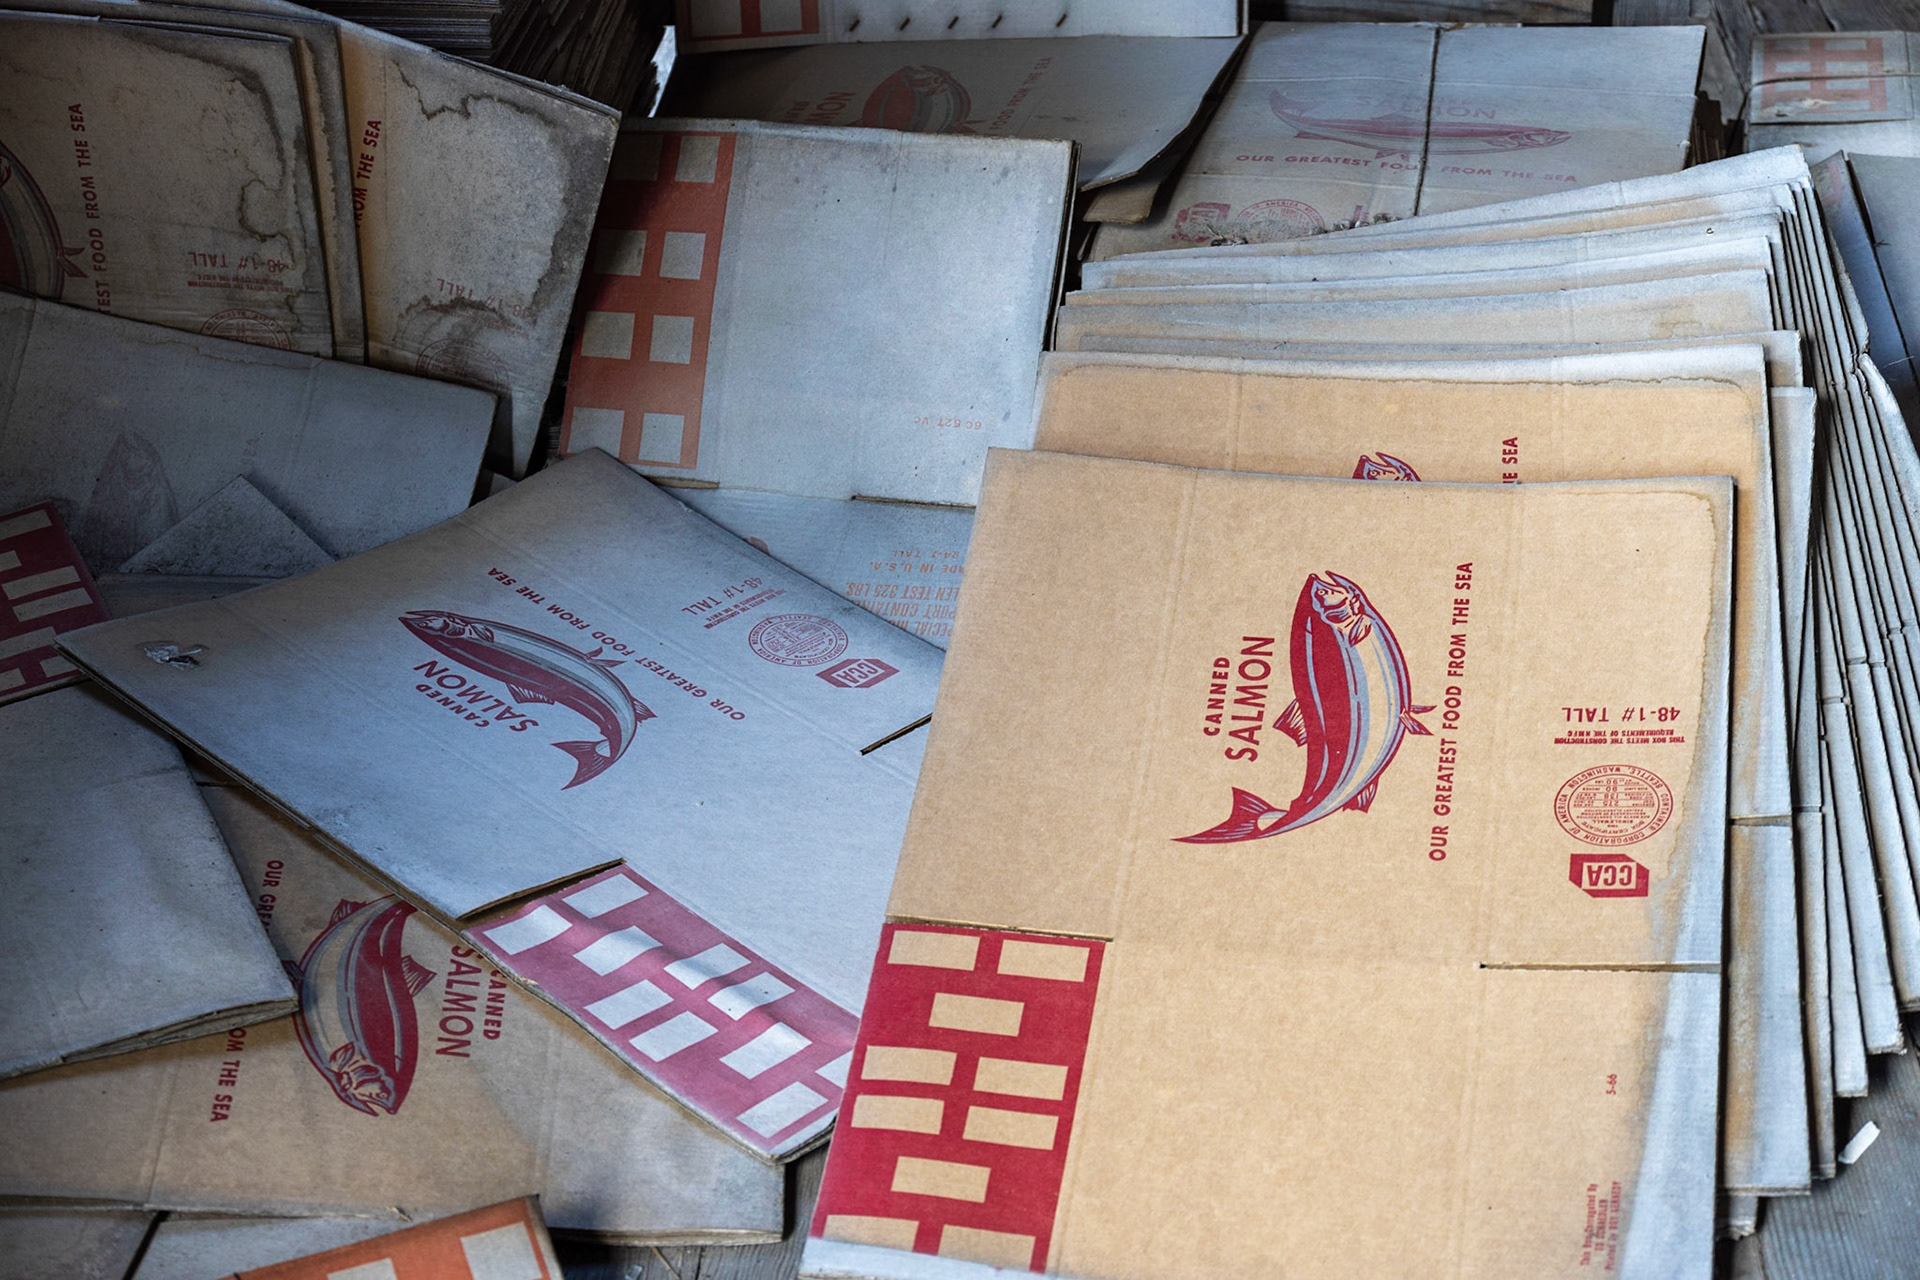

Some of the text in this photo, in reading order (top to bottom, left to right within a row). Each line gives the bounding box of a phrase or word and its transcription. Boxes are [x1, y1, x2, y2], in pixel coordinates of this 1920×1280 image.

[68, 103, 85, 132] SEA
[75, 139, 92, 168] THE
[1236, 155, 1275, 163] OUR
[1284, 155, 1373, 168] GREATEST
[1441, 166, 1493, 177] FROM
[1502, 170, 1534, 180] THE
[353, 120, 382, 228] ROM THE SEA
[80, 176, 100, 219] FROM
[89, 228, 107, 272] FOOD
[188, 252, 229, 268] TALL
[1501, 436, 1518, 465] SEA
[920, 563, 935, 573] IN
[681, 576, 763, 616] 48-1# TALL
[873, 584, 899, 599] 325
[901, 585, 932, 601] TEST
[487, 567, 746, 721] OUR GREATEST FOOD FROM THE SEA
[836, 662, 879, 685] CCA
[413, 660, 539, 732] SALMON
[415, 684, 490, 728] CANNED
[1203, 657, 1230, 736] CANNED
[1224, 636, 1275, 762] SALMON
[1428, 562, 1473, 861] OUR GREATEST FOOD FROM THE SEA
[1562, 706, 1681, 722] 48-1# TALL
[1554, 737, 1607, 745] CONSTRUCTION
[1568, 767, 1621, 789] WASHINGTON
[1558, 794, 1571, 823] AMERICA
[1648, 793, 1669, 831] CONTAINER
[1569, 827, 1581, 835] OF
[1583, 831, 1646, 844] CORPORATION
[262, 860, 284, 887] OUR
[1587, 865, 1633, 886] CCA
[435, 945, 484, 1058] SALMON
[218, 1060, 240, 1087] THE
[210, 1094, 233, 1122] SEA
